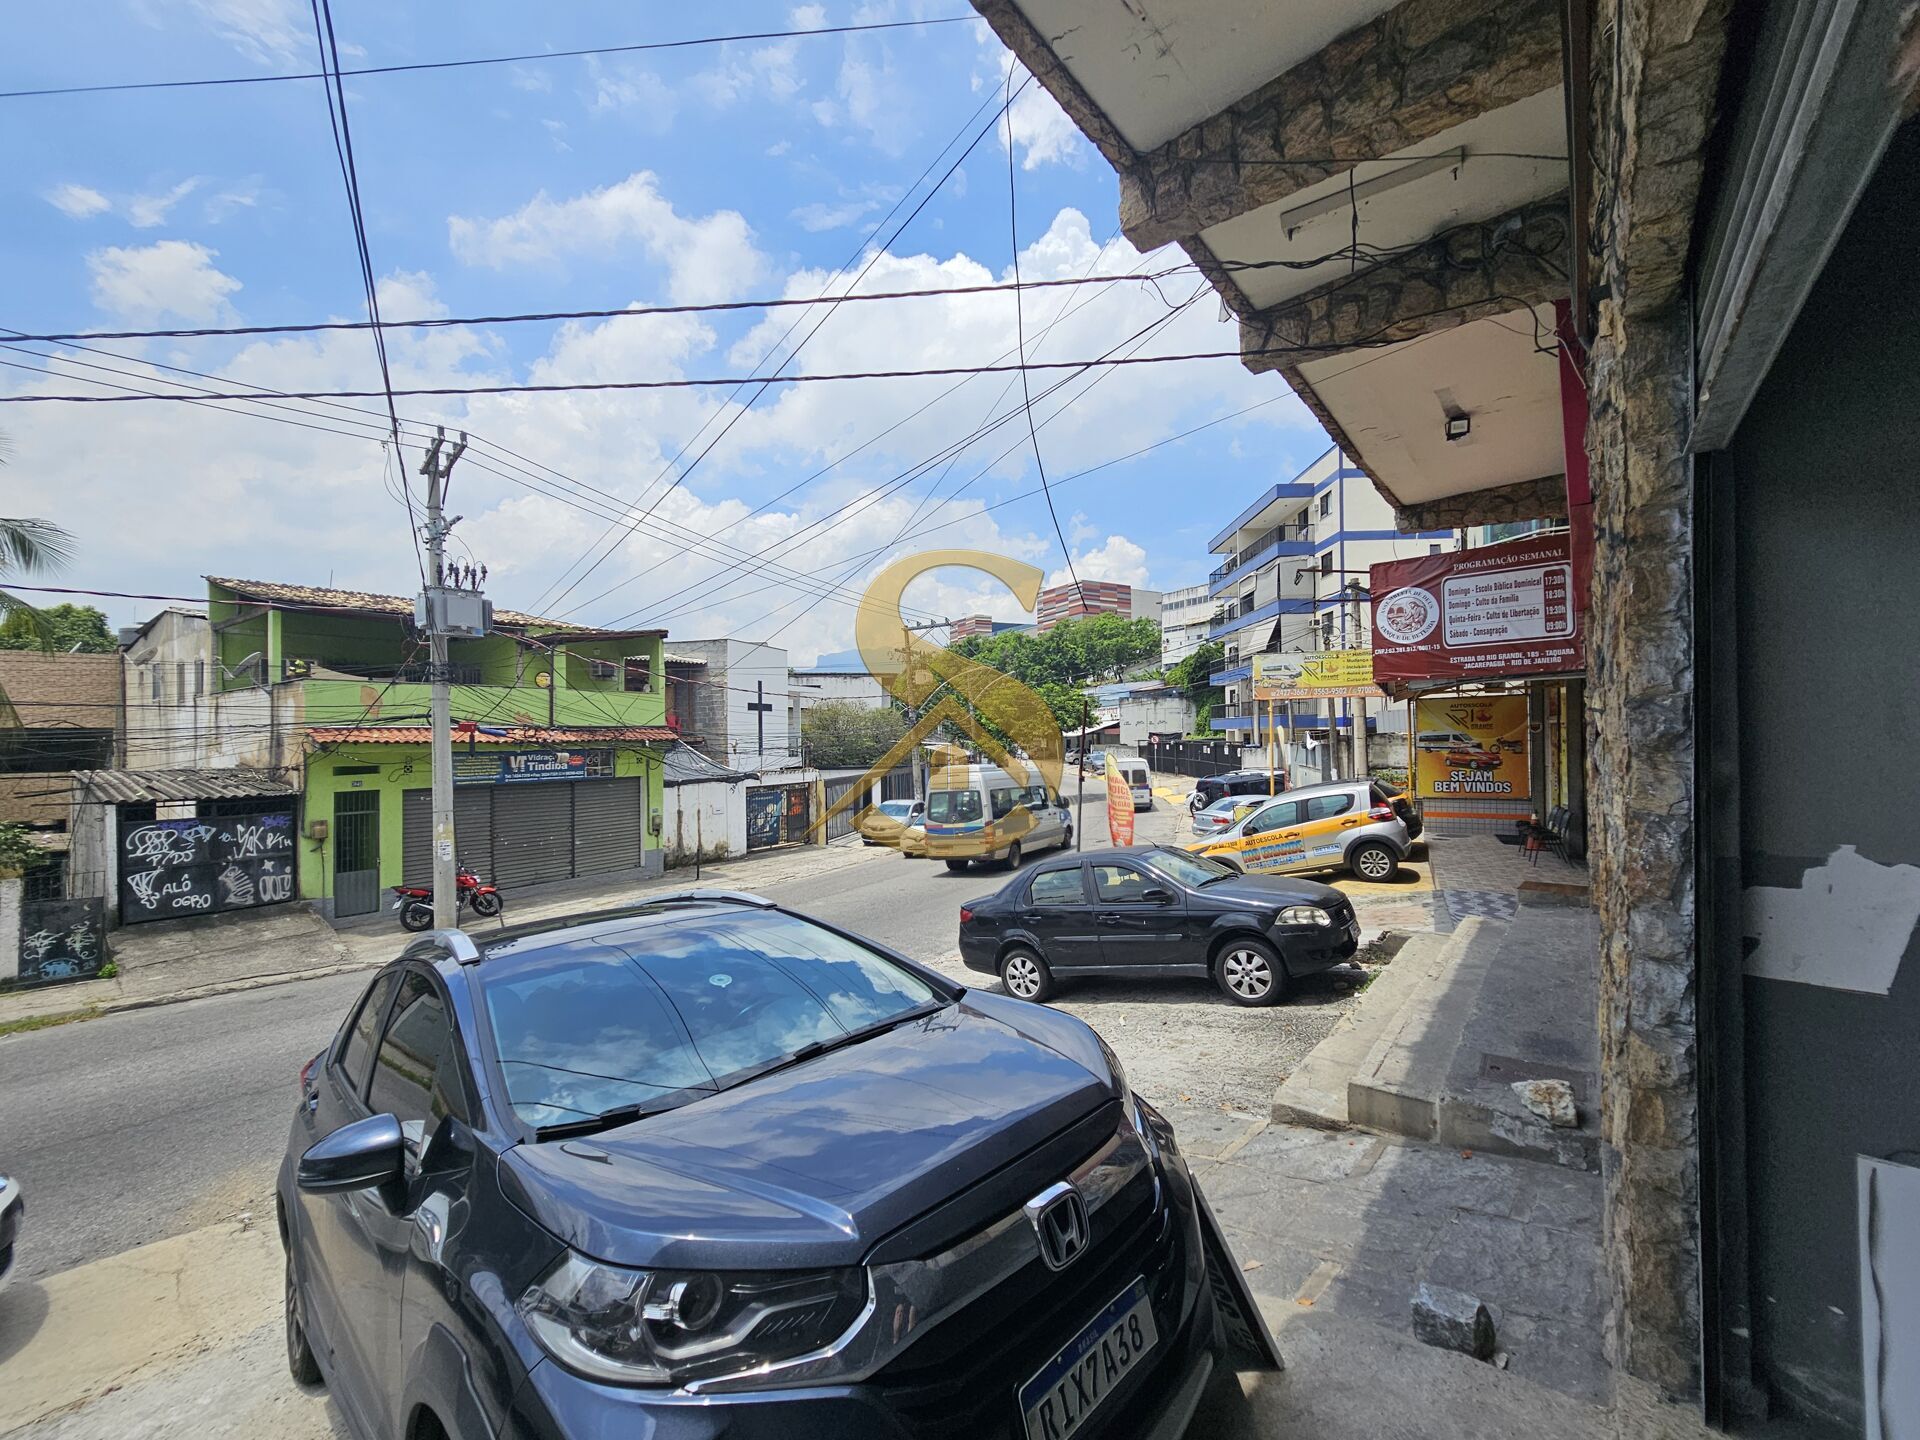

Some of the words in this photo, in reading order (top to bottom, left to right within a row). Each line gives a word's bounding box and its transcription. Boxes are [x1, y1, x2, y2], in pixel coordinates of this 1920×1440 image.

[1453, 554, 1518, 570] PROGRAMAÇÃO
[1520, 549, 1564, 560] SEMANAL
[1448, 587, 1470, 596] Domingo
[1476, 584, 1492, 593] Escola
[1494, 582, 1513, 591] Bíblica
[1514, 577, 1542, 588] Dominical
[1448, 600, 1470, 609] Domingo
[1476, 598, 1489, 607] Culto
[1491, 597, 1498, 605] da
[1499, 594, 1519, 603] Família
[1449, 613, 1481, 625] Quinta-Feira
[1486, 611, 1500, 620] Culto
[1502, 610, 1508, 618] de
[1510, 606, 1540, 618] Libertação
[1450, 629, 1469, 638] Sábado
[1473, 625, 1508, 637] Consagração
[1545, 648, 1575, 657] TAQUARA
[1533, 656, 1562, 664] JANEIRO
[527, 761, 568, 771] Tindiba
[1450, 771, 1493, 782] SEJAM
[1434, 781, 1459, 792] BEM
[1465, 782, 1511, 793] VINDOS
[1245, 834, 1283, 846] AUTOESCOLA
[162, 873, 191, 896] ALÔ
[172, 894, 211, 909] OGRO
[1039, 1313, 1144, 1440] RIX7A38
